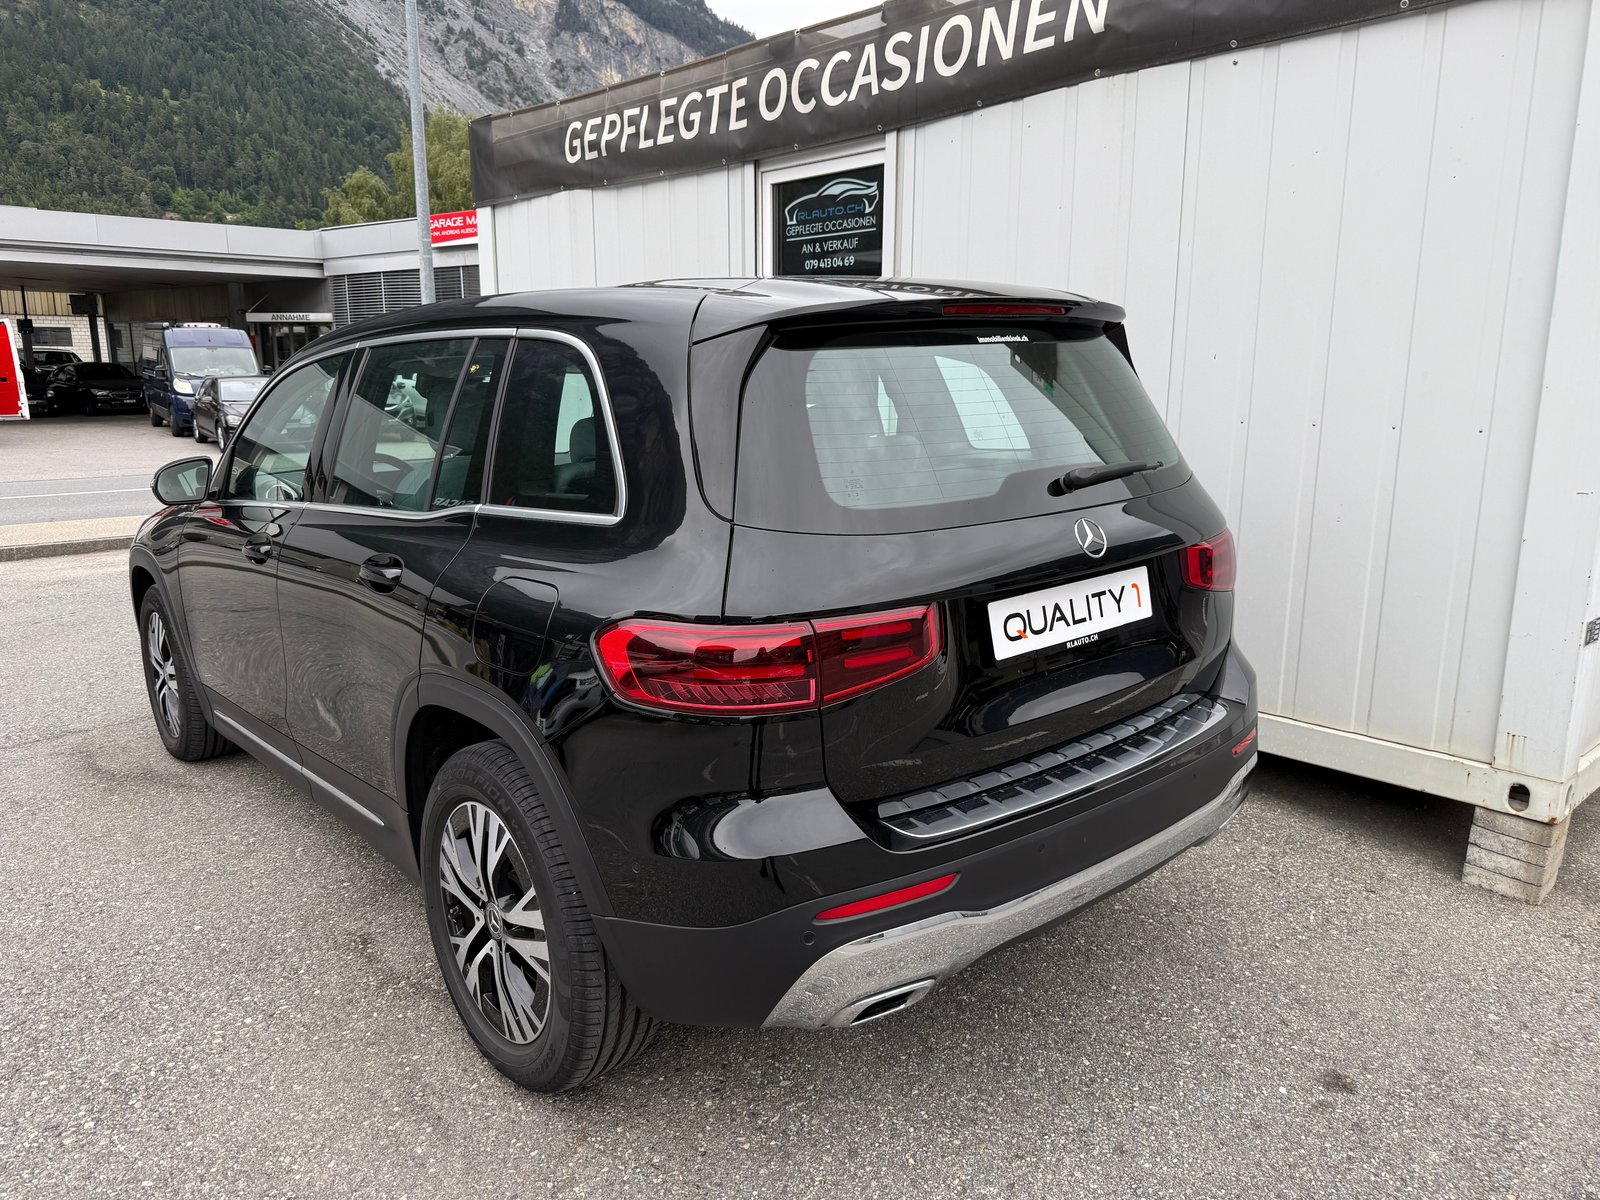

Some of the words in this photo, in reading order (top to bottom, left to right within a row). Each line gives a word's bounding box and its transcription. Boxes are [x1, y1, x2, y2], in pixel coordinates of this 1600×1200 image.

[565, 76, 748, 164] GEPFLEGTE
[758, 0, 1107, 121] OCCASIONEN
[797, 204, 864, 220] RLAUTO.CH
[786, 222, 823, 236] GEPFLEGTE
[824, 215, 876, 231] OCCASIONEN
[801, 242, 814, 254] AN
[815, 243, 821, 253] &
[822, 238, 859, 250] VERKAUF
[804, 260, 818, 270] 079
[819, 258, 832, 268] 413
[832, 257, 843, 267] 04
[844, 255, 855, 266] 69
[1003, 585, 1125, 642] QUALITY
[1131, 583, 1141, 608] 1
[1066, 634, 1099, 649] RLAUTO.CH
